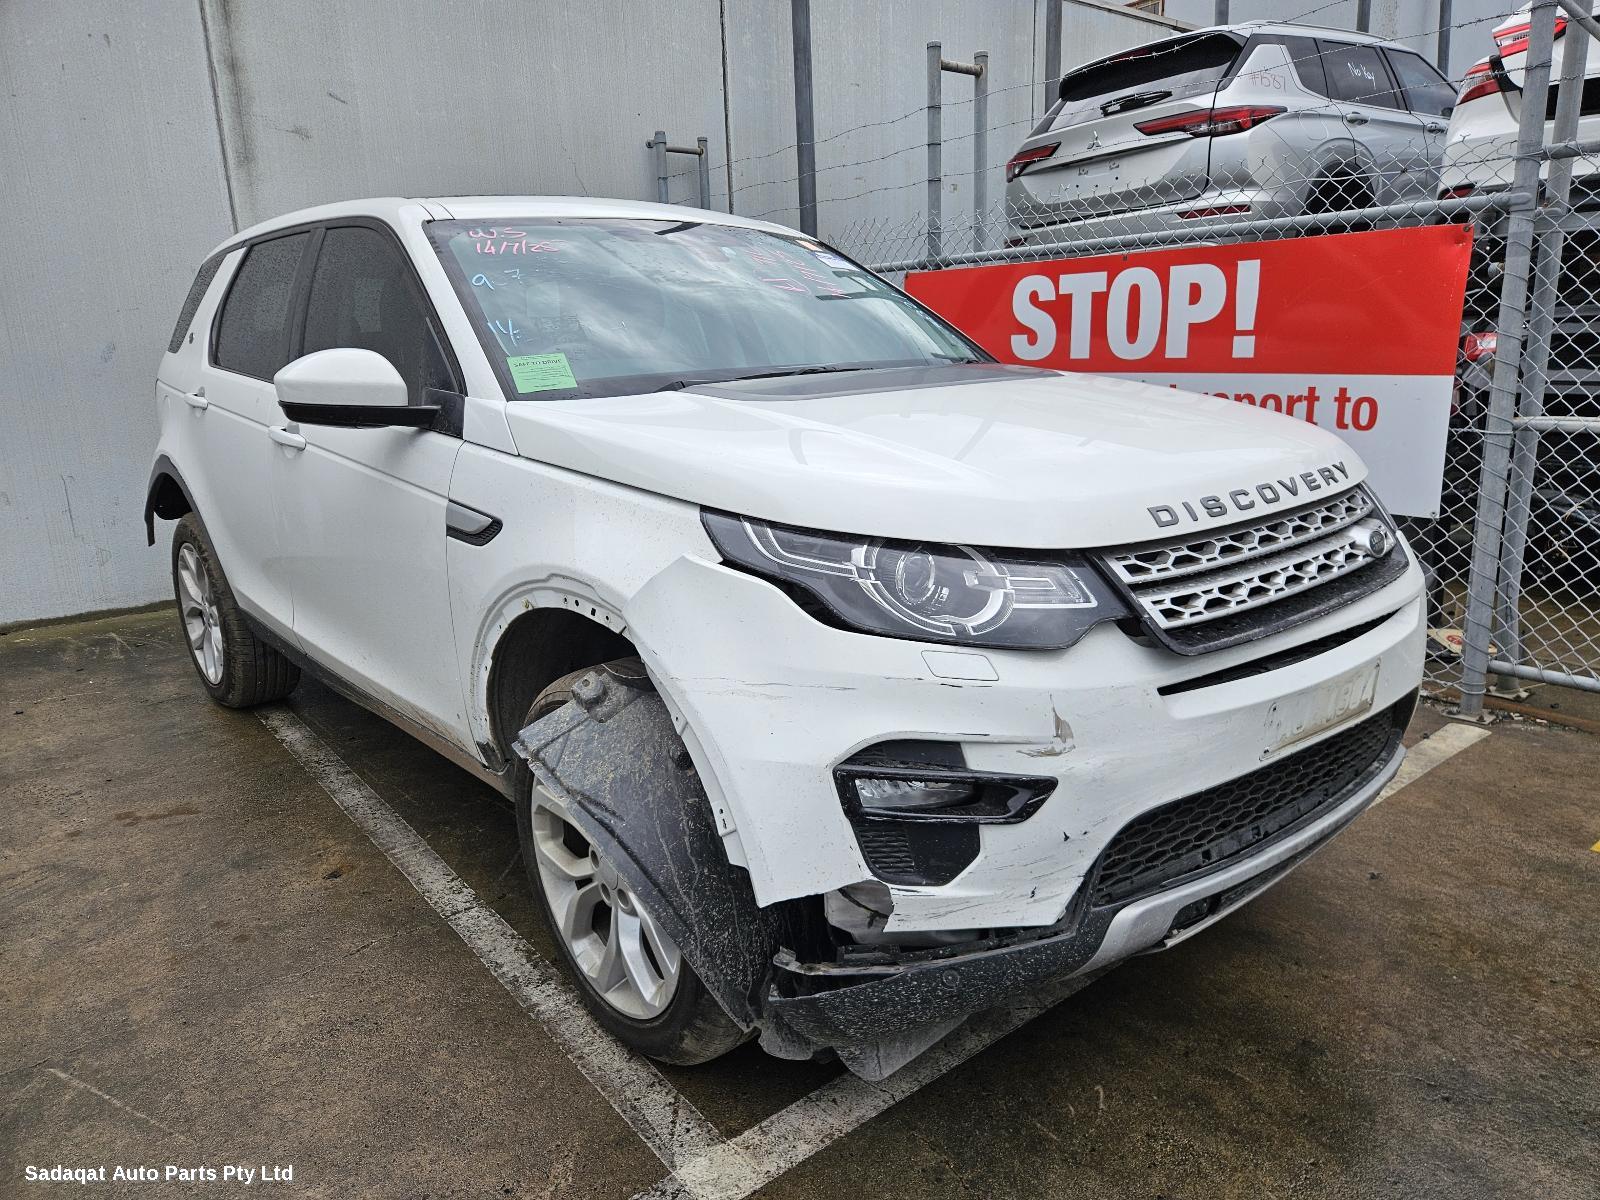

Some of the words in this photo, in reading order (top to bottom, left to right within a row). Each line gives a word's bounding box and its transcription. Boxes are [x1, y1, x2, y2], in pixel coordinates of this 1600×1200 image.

[1010, 259, 1261, 361] STOP!
[1334, 387, 1379, 432] to
[1147, 461, 1350, 528] DISCOVERY
